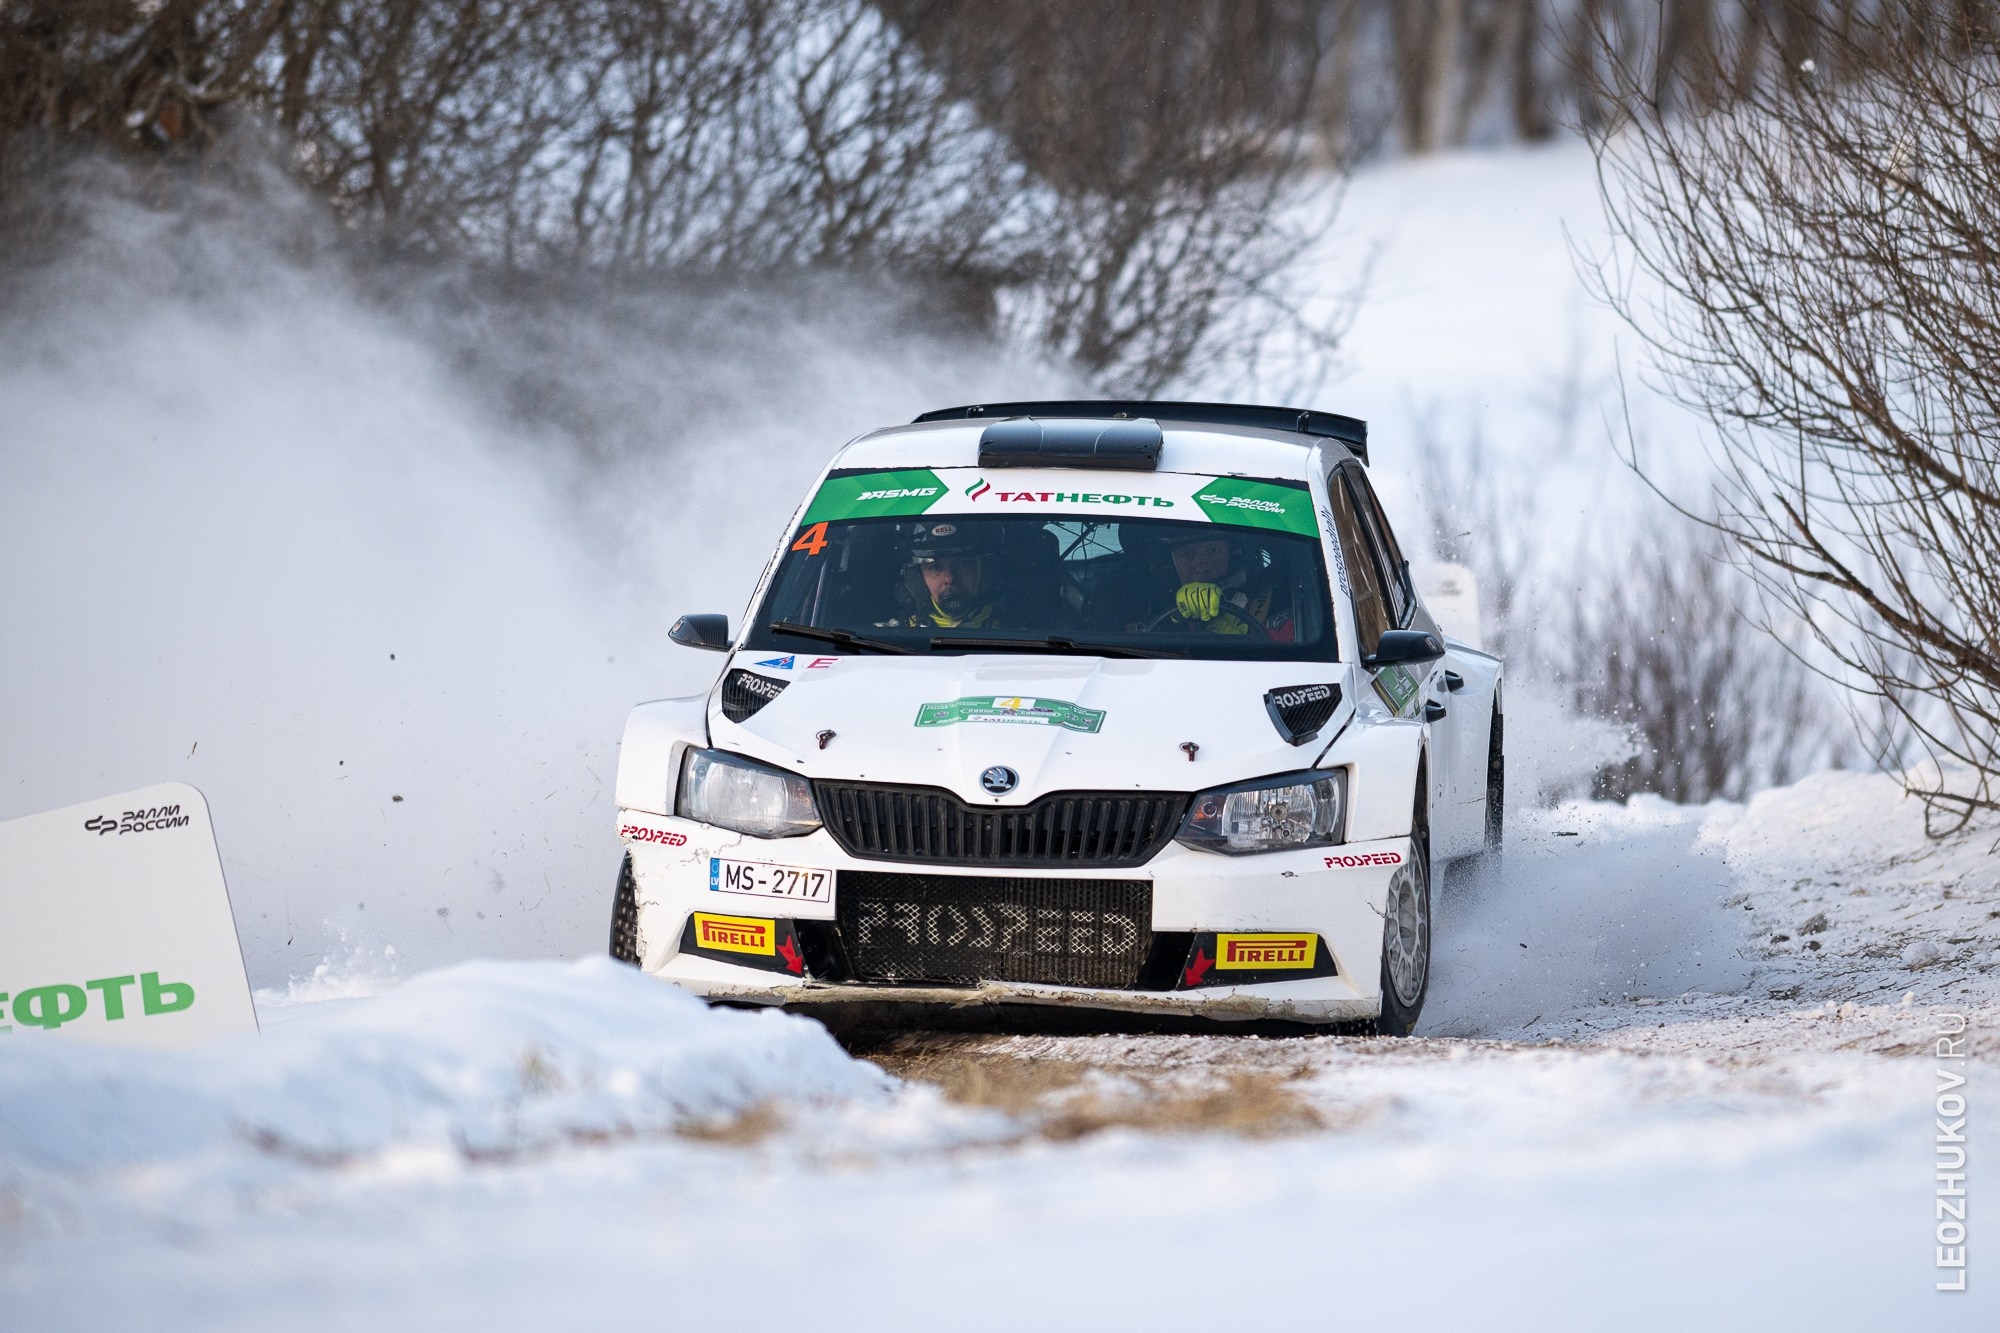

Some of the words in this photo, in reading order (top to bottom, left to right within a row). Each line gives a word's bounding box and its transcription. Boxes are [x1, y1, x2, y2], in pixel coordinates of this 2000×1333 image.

[996, 492, 1174, 508] ТАТНЕФТЬ
[1226, 501, 1286, 514] РОССИИ
[1229, 496, 1280, 508] РАЛЛИ
[935, 526, 953, 534] BELL
[792, 522, 829, 556] 4
[807, 658, 838, 668] E
[1000, 697, 1022, 710] 4
[121, 804, 180, 823] РАЛЛИ
[119, 815, 189, 835] РОССИИ
[620, 824, 687, 847] PROSPEED
[1324, 852, 1401, 868] PROSPEED
[711, 877, 719, 886] LV
[725, 863, 825, 898] MS-2717
[702, 920, 766, 947] PIRELLI
[859, 902, 1137, 954] PROSPEED
[1227, 940, 1307, 962] PIRELLI
